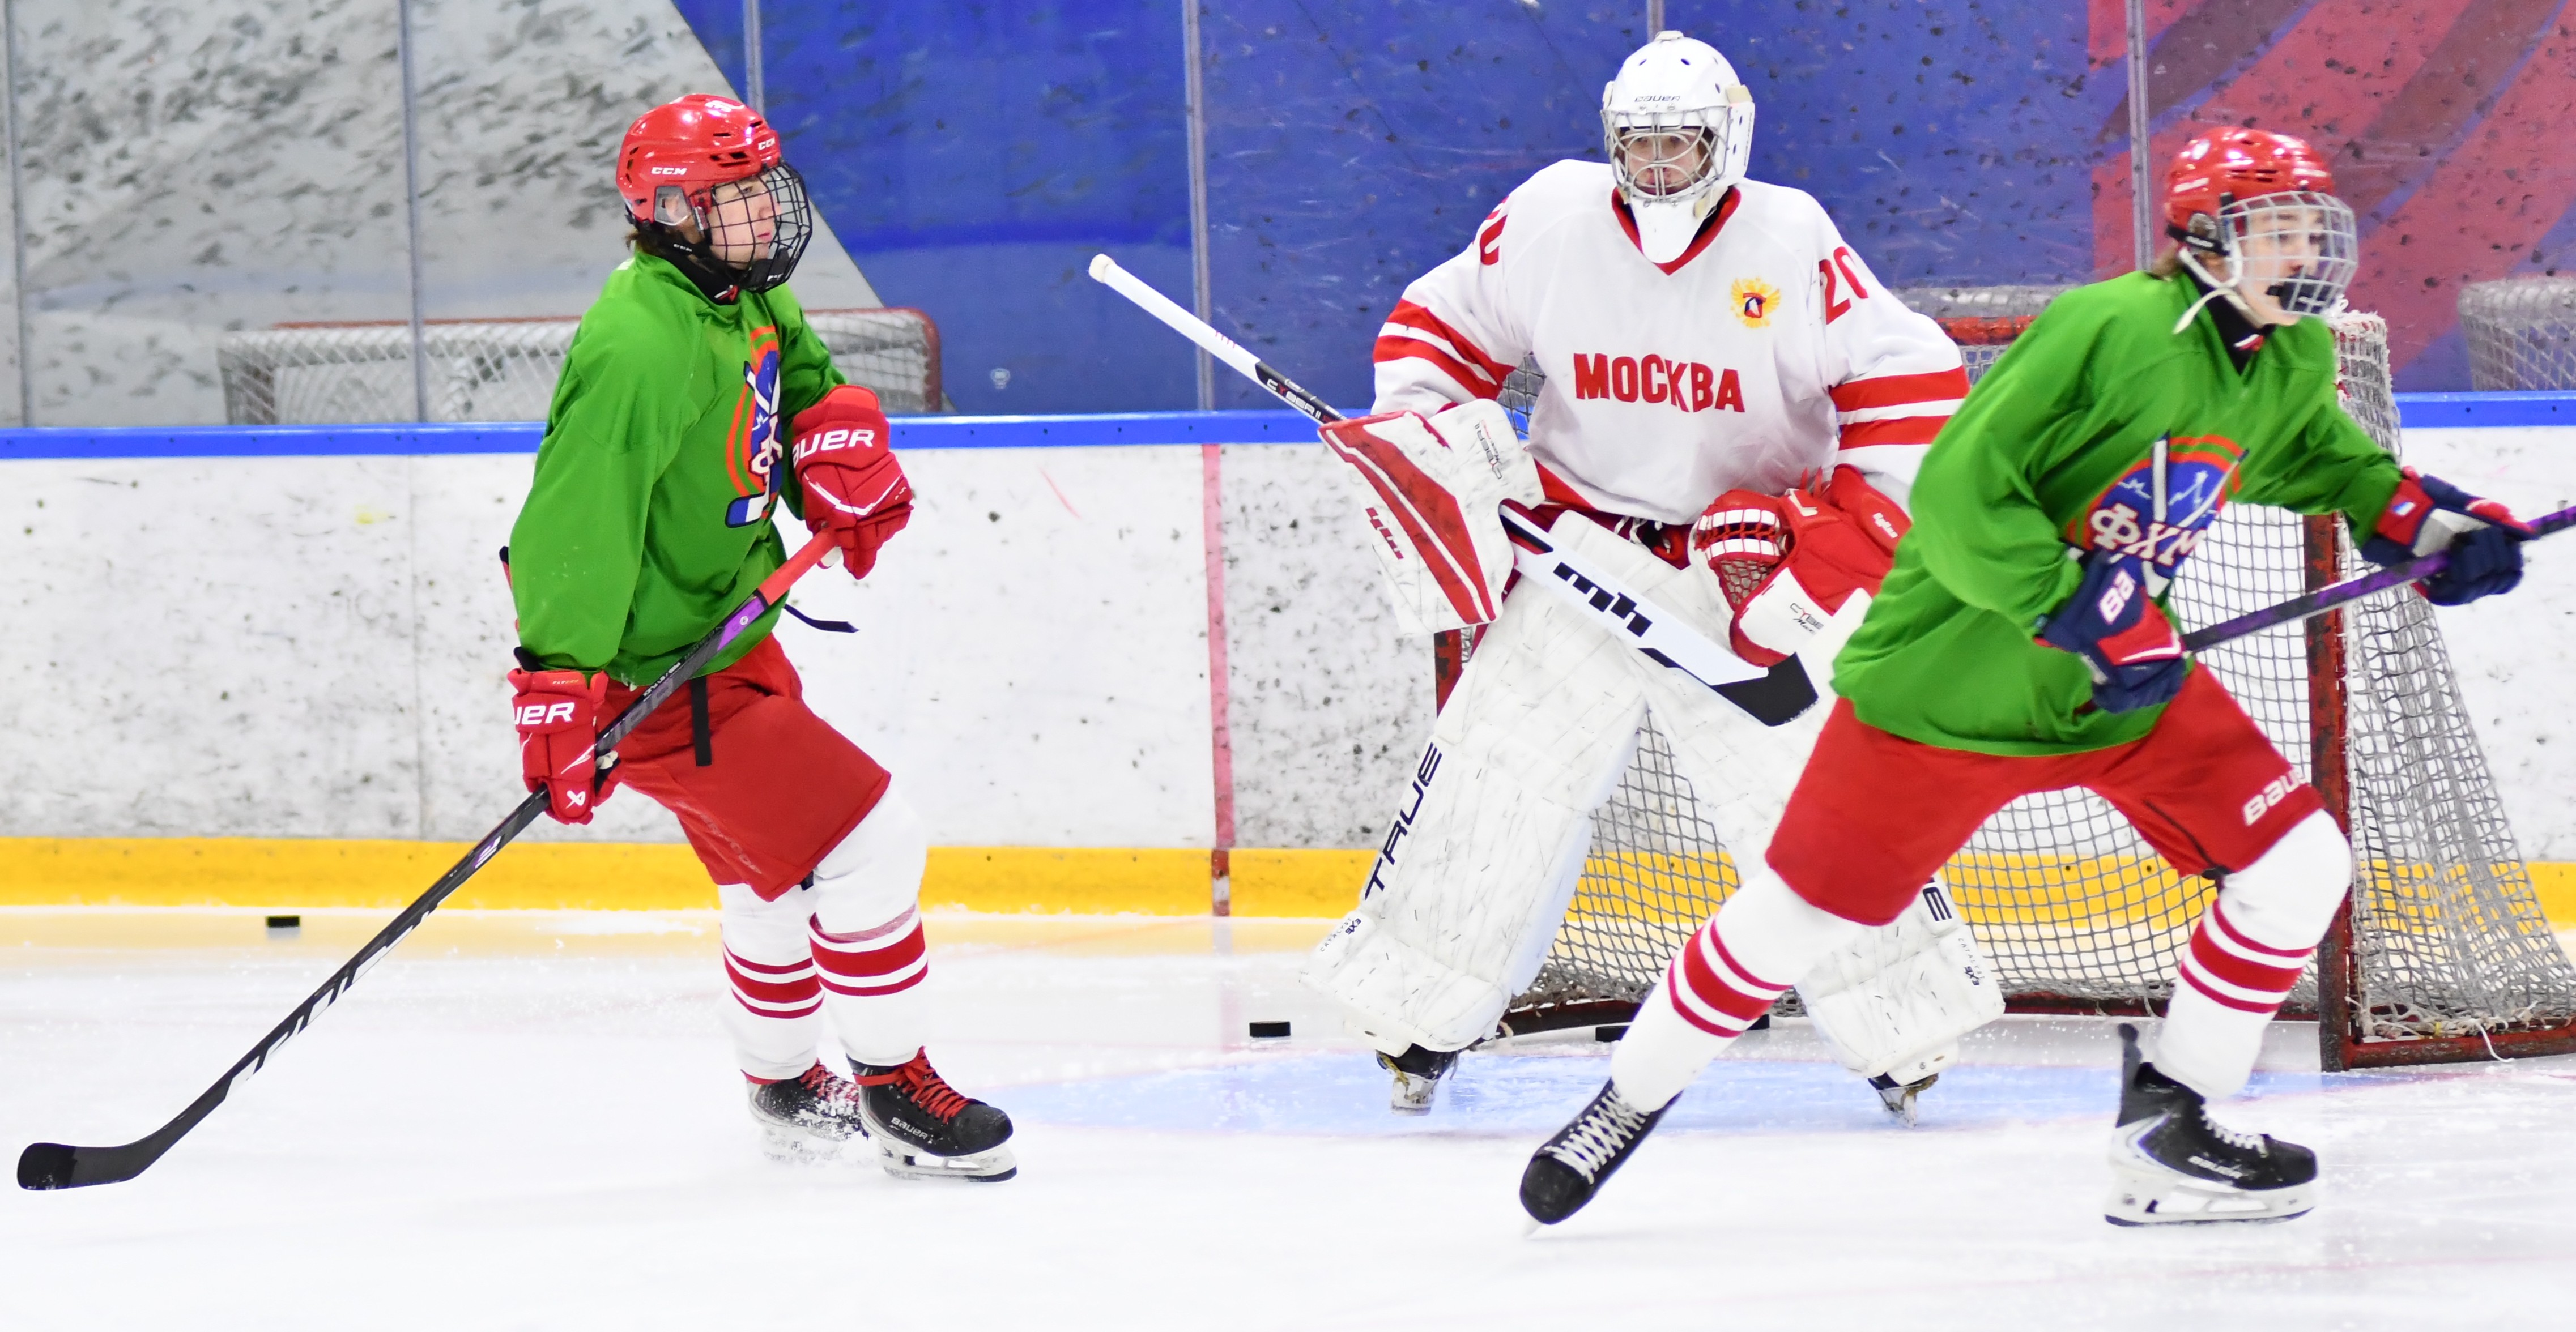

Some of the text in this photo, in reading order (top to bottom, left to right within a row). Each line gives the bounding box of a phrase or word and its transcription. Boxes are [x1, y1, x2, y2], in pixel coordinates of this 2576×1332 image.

[651, 166, 687, 176] CCM
[1573, 353, 1745, 413] МОСКВА
[1364, 742, 1442, 900] TRUE
